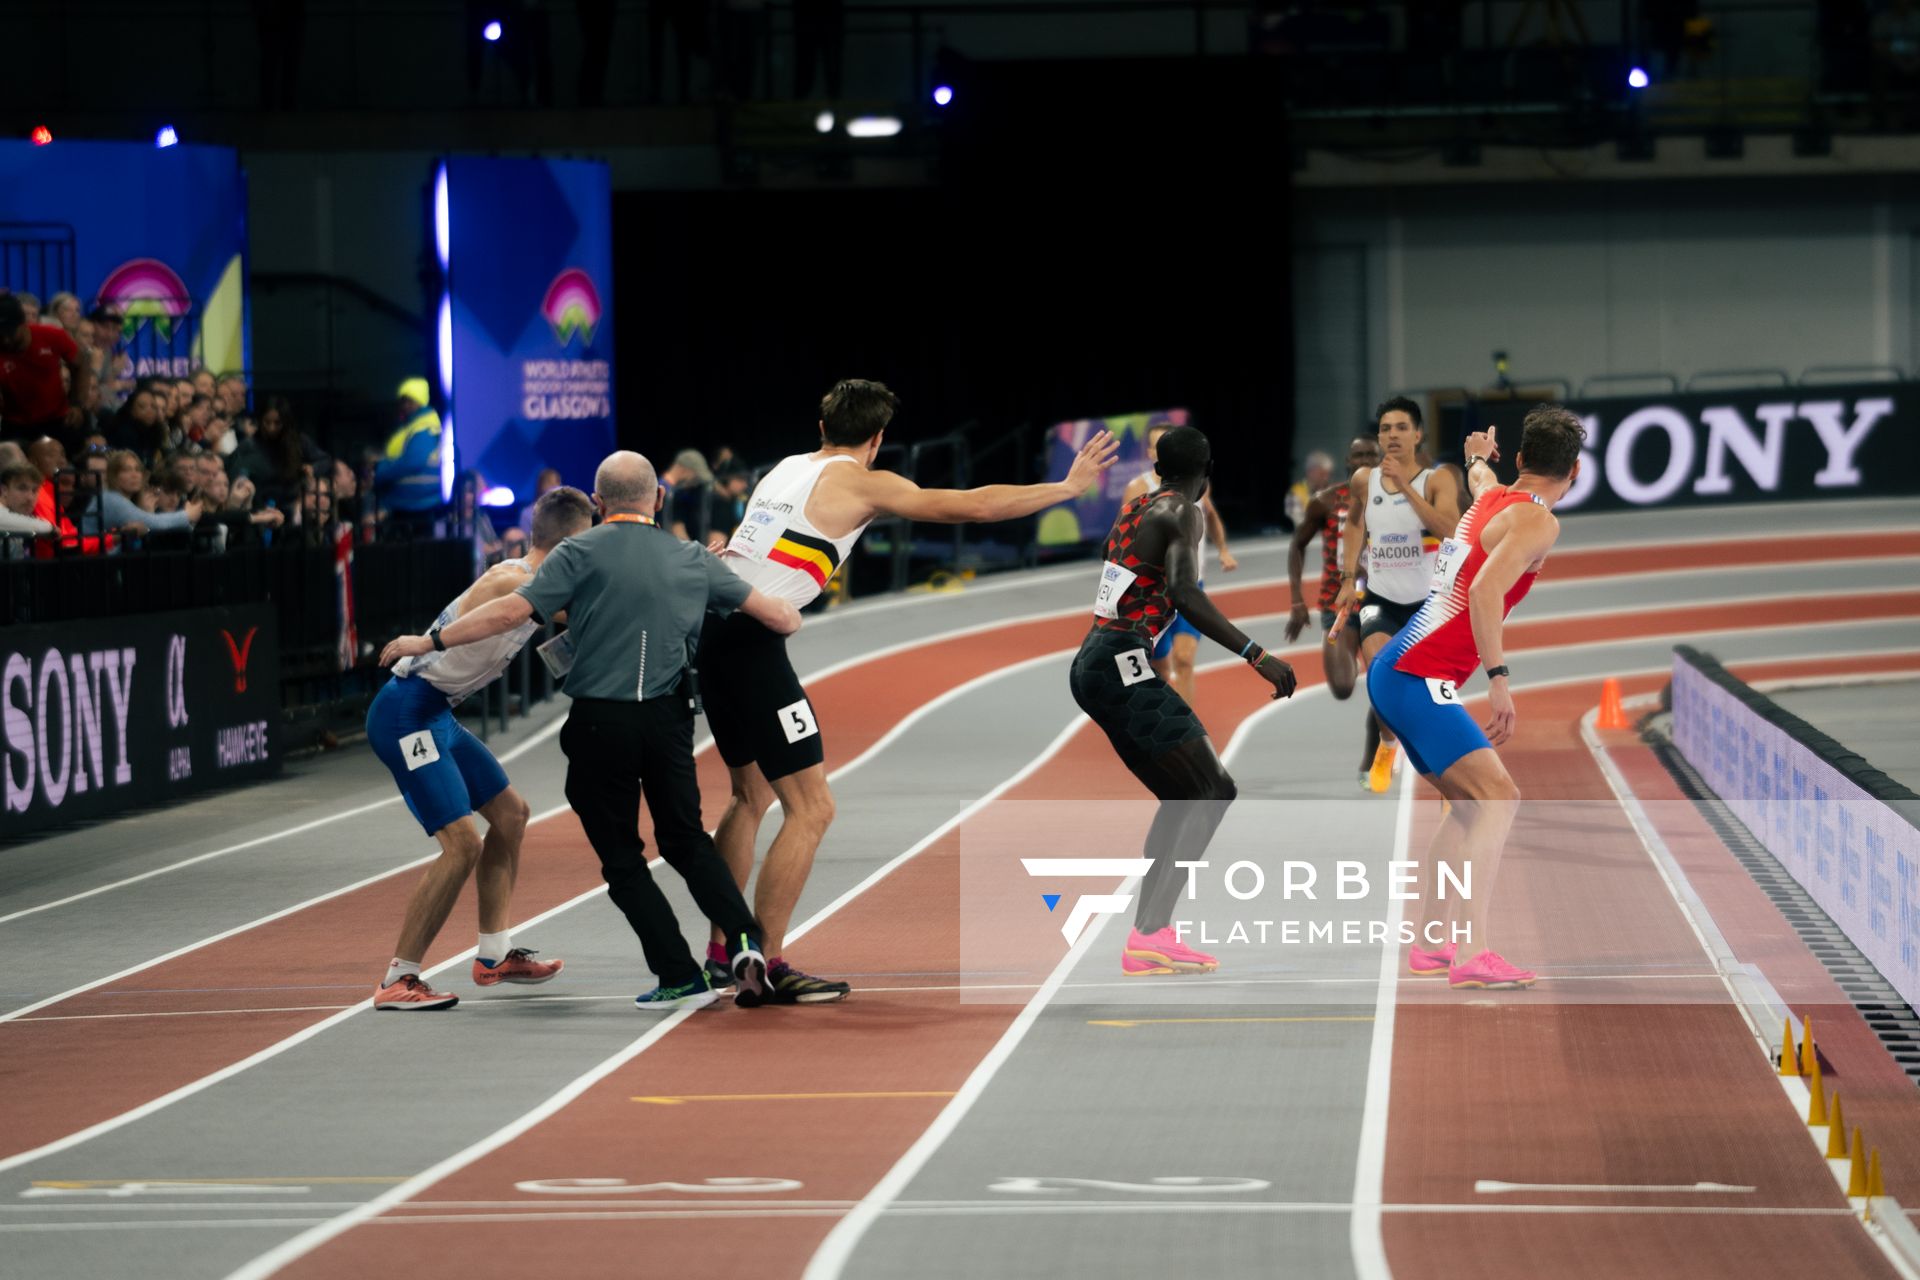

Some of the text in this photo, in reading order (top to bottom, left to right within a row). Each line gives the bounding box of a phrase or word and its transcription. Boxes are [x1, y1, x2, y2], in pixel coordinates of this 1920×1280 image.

[1371, 546, 1420, 560] SACOOR
[1127, 655, 1143, 677] 3
[1439, 681, 1453, 700] 6
[3, 647, 136, 813] SONY
[791, 711, 807, 734] 5
[412, 737, 428, 759] 4
